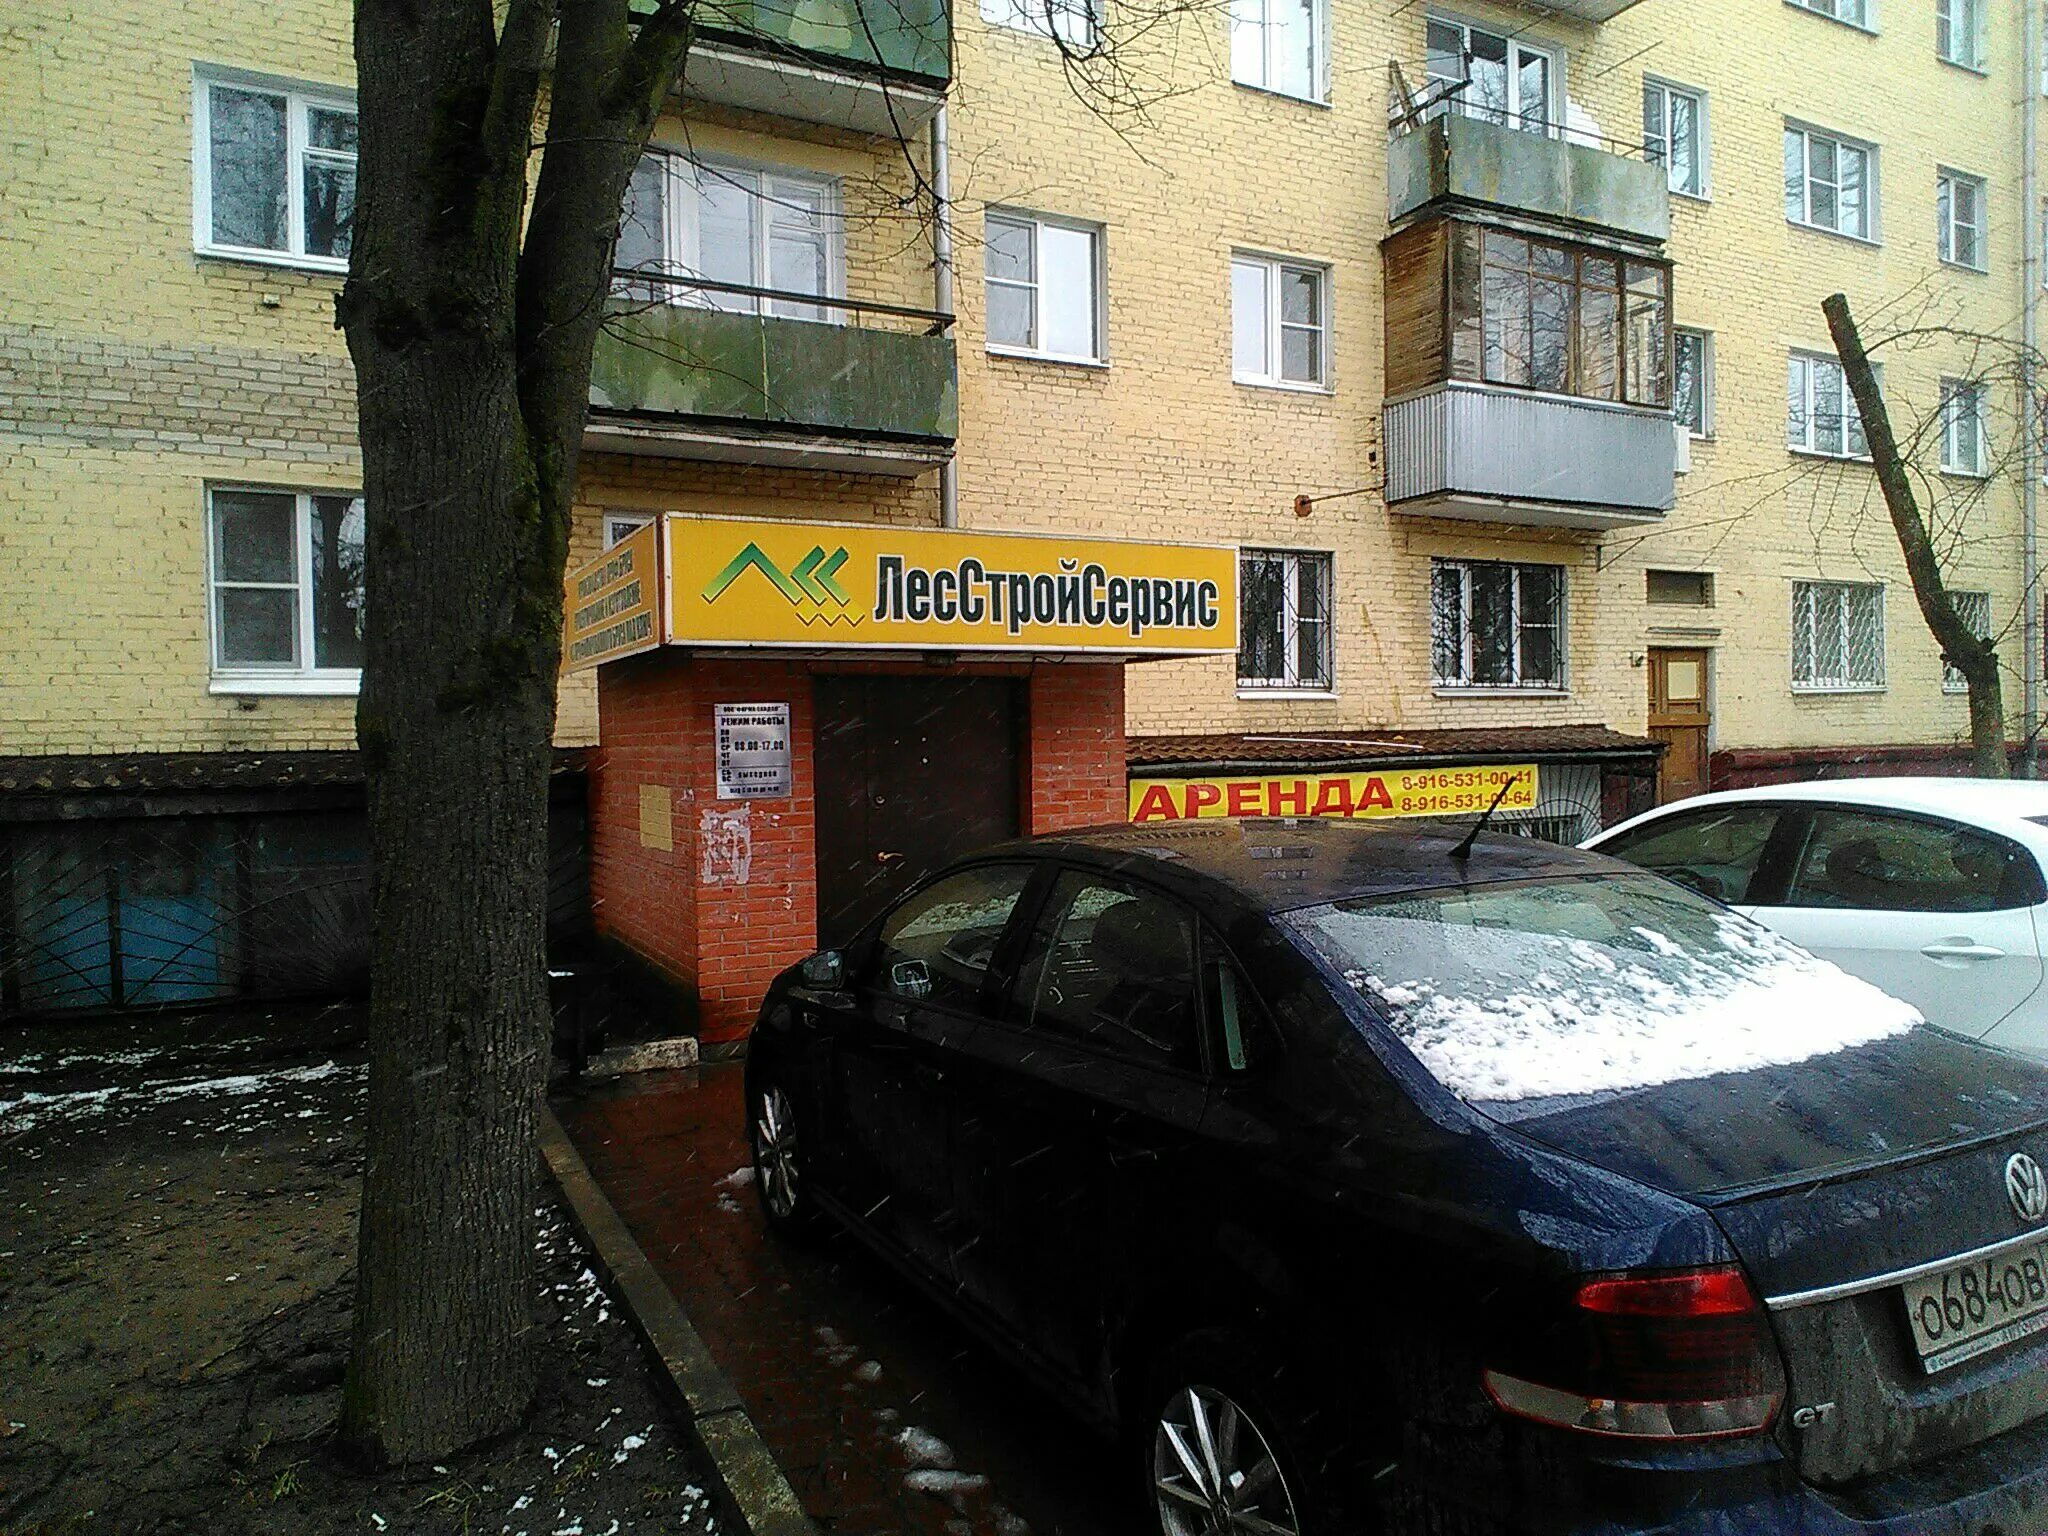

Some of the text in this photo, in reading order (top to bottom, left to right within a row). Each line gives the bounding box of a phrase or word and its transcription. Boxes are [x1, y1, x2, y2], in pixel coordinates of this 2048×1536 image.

[873, 555, 1219, 637] ЛесСтройСервис
[721, 716, 785, 726] РЕЖИМ РАБОТЫ
[1402, 770, 1532, 791] 8-916-531-0041
[1132, 777, 1394, 823] АРЕНДА
[1793, 1402, 1837, 1429] GT
